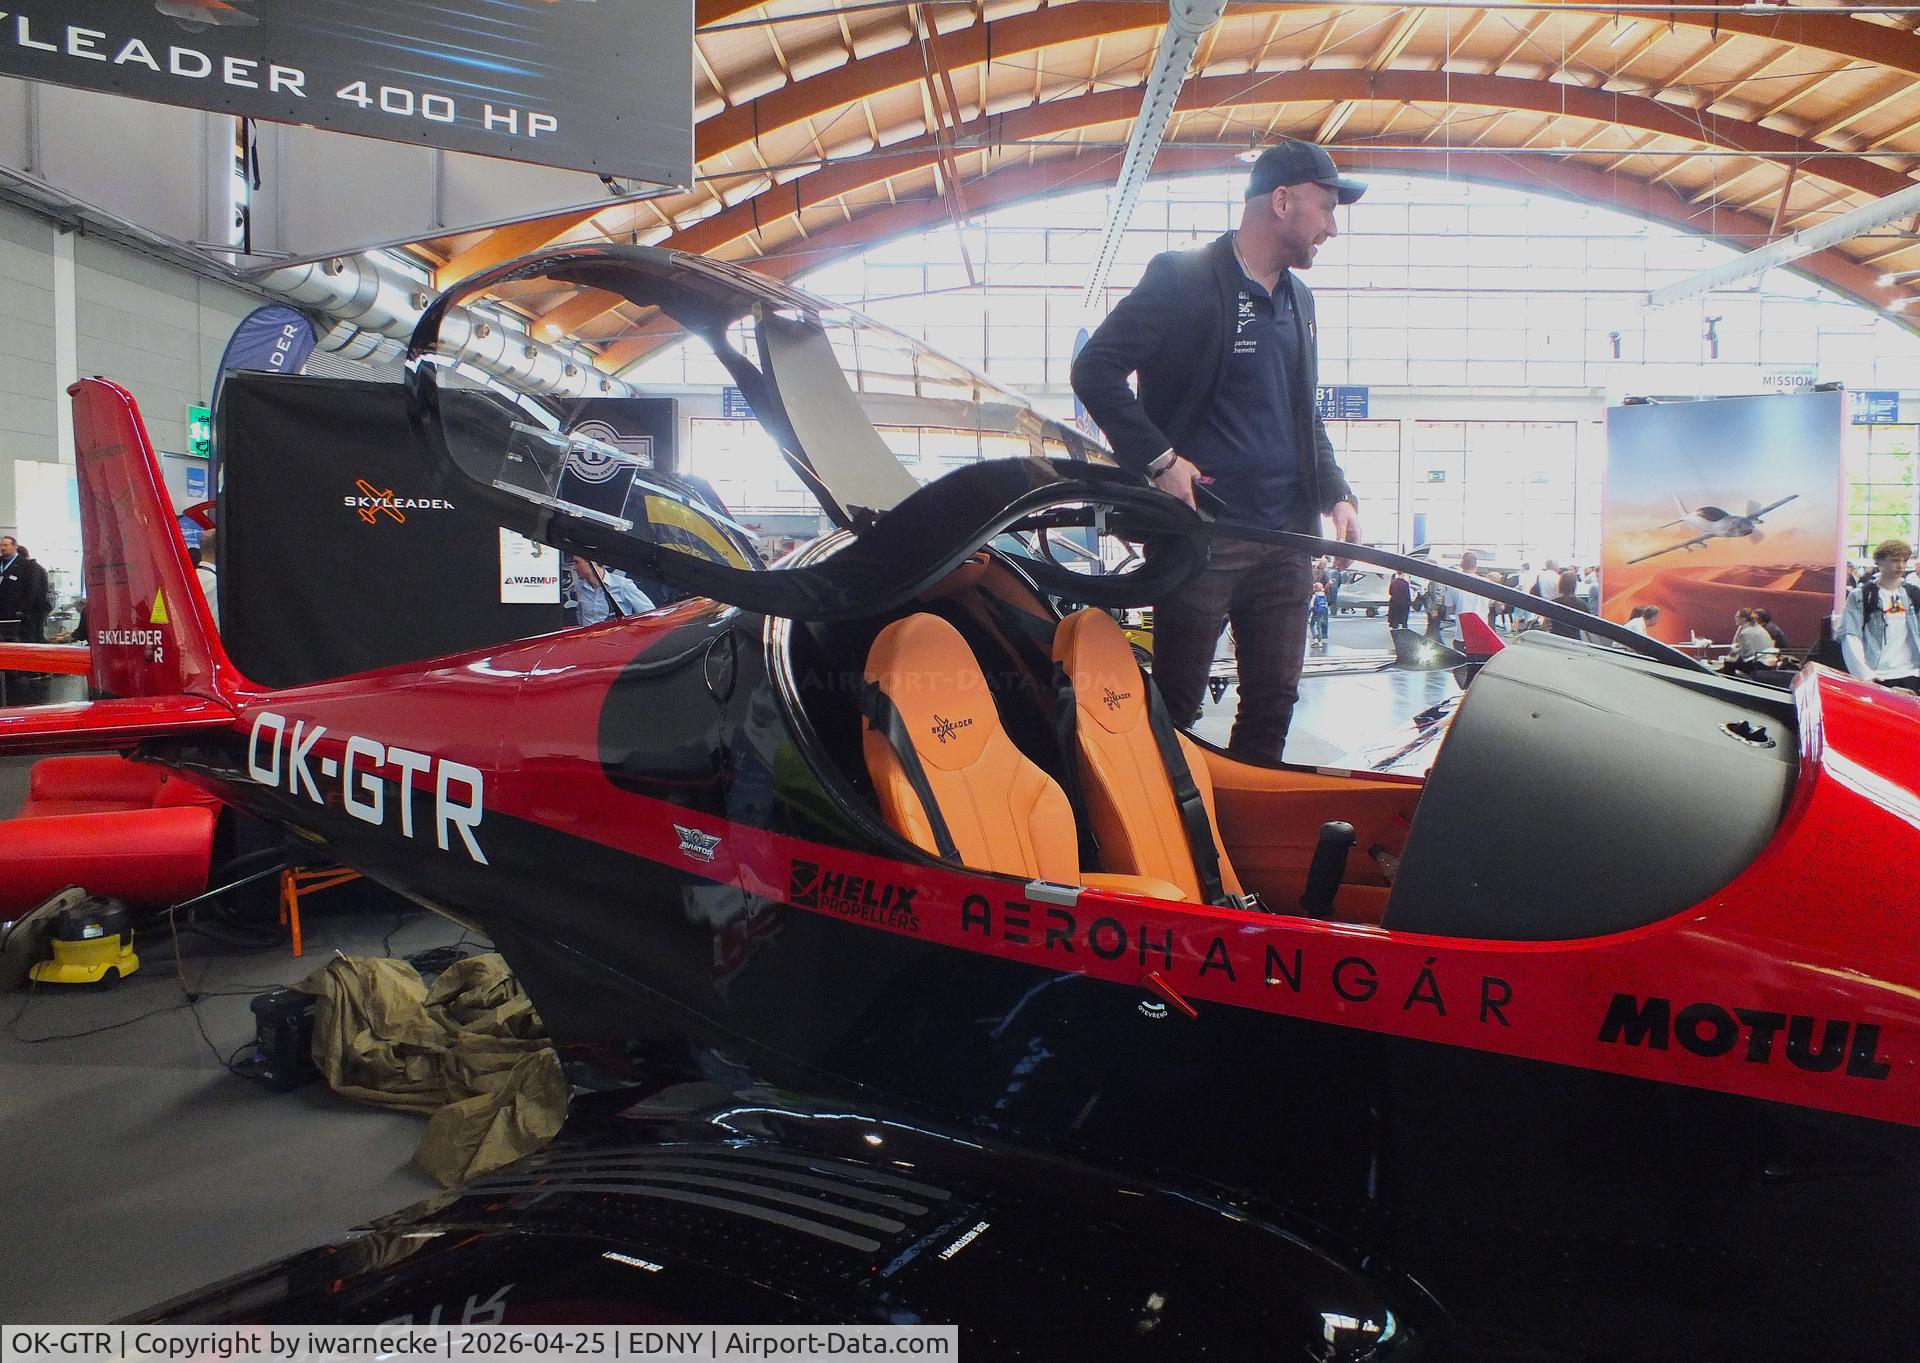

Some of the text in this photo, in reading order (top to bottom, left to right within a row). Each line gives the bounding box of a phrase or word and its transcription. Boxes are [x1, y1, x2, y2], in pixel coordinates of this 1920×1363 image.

[0, 12, 558, 137] LEADER 400 HP
[266, 324, 298, 372] DER
[1316, 387, 1334, 401] B1
[1763, 376, 1812, 386] MISSION
[514, 576, 558, 585] WARMUP
[98, 630, 162, 646] SKYLEADER
[931, 718, 973, 734] SKYLEADER
[248, 711, 489, 866] OK-GTR
[681, 841, 713, 857] AVIATOR
[820, 869, 919, 914] HELIX
[821, 896, 919, 932] PROPELLERS
[961, 893, 1514, 1027] AEROHANGÁR
[1596, 993, 1892, 1081] MOTUL
